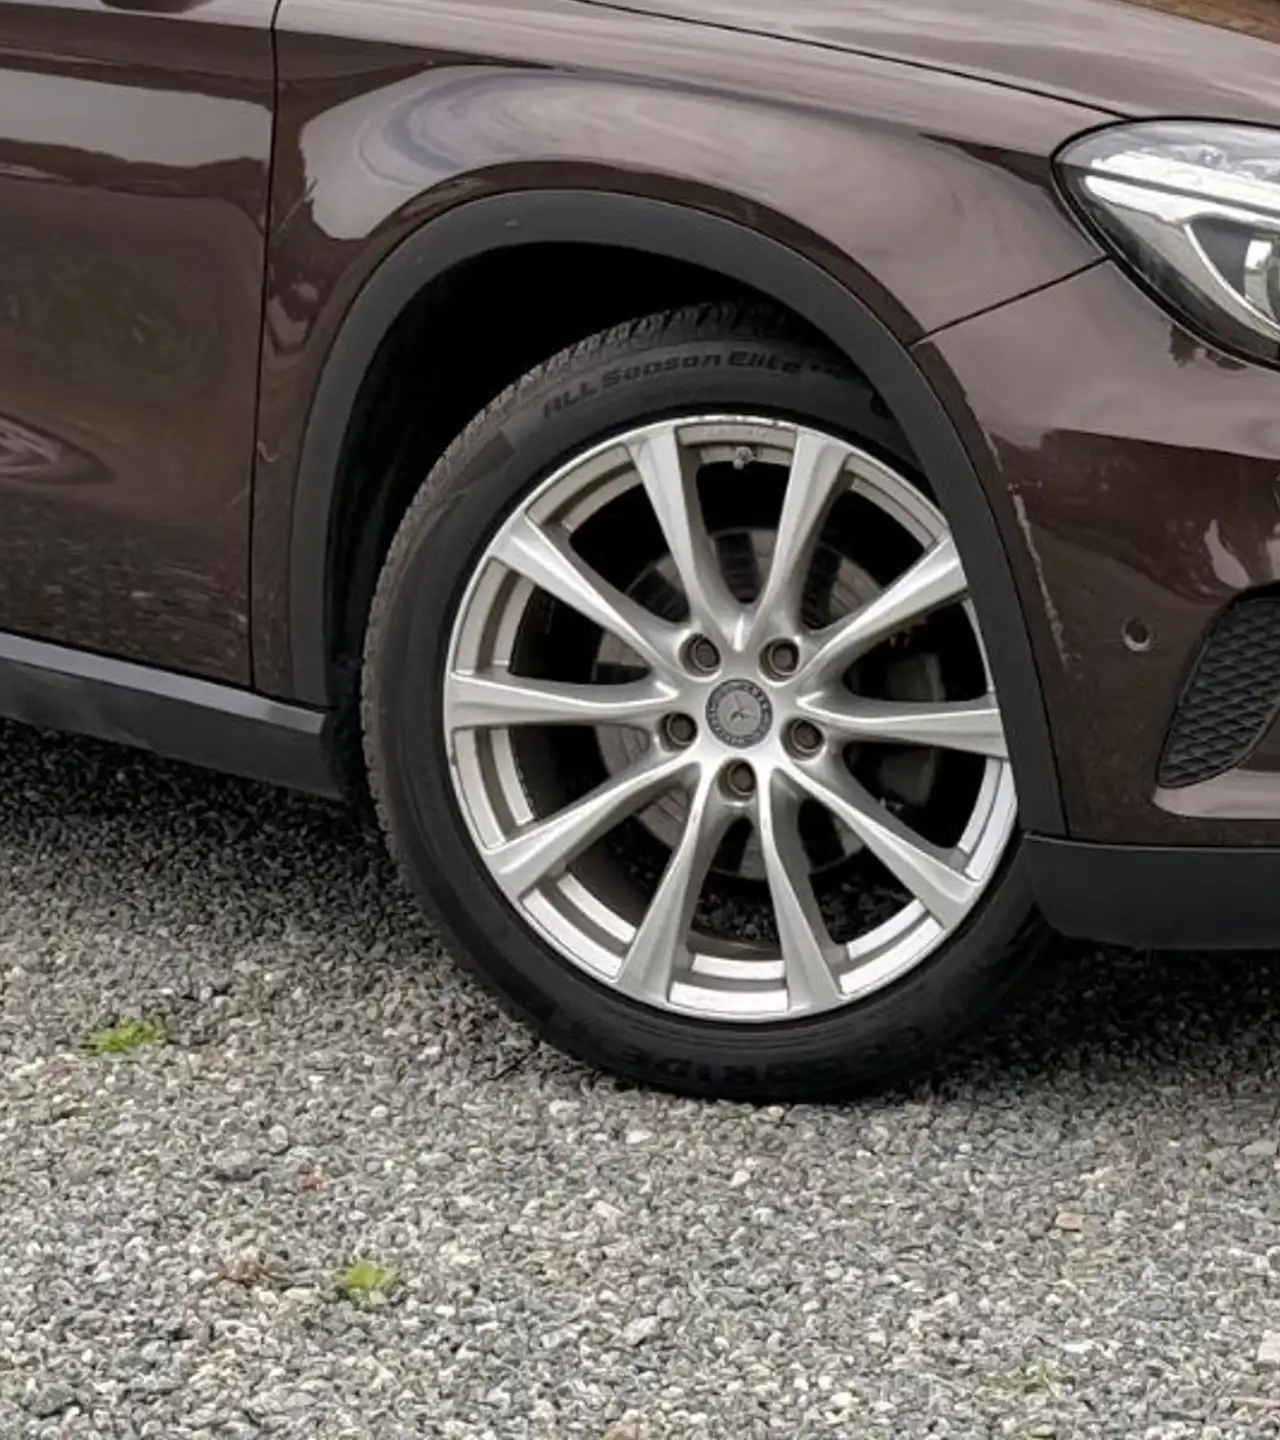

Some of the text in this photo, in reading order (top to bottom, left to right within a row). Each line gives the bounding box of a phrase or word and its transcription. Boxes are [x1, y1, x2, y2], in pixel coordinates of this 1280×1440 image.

[543, 381, 598, 419] ALL
[601, 353, 721, 389] Season
[728, 349, 803, 375] Elite
